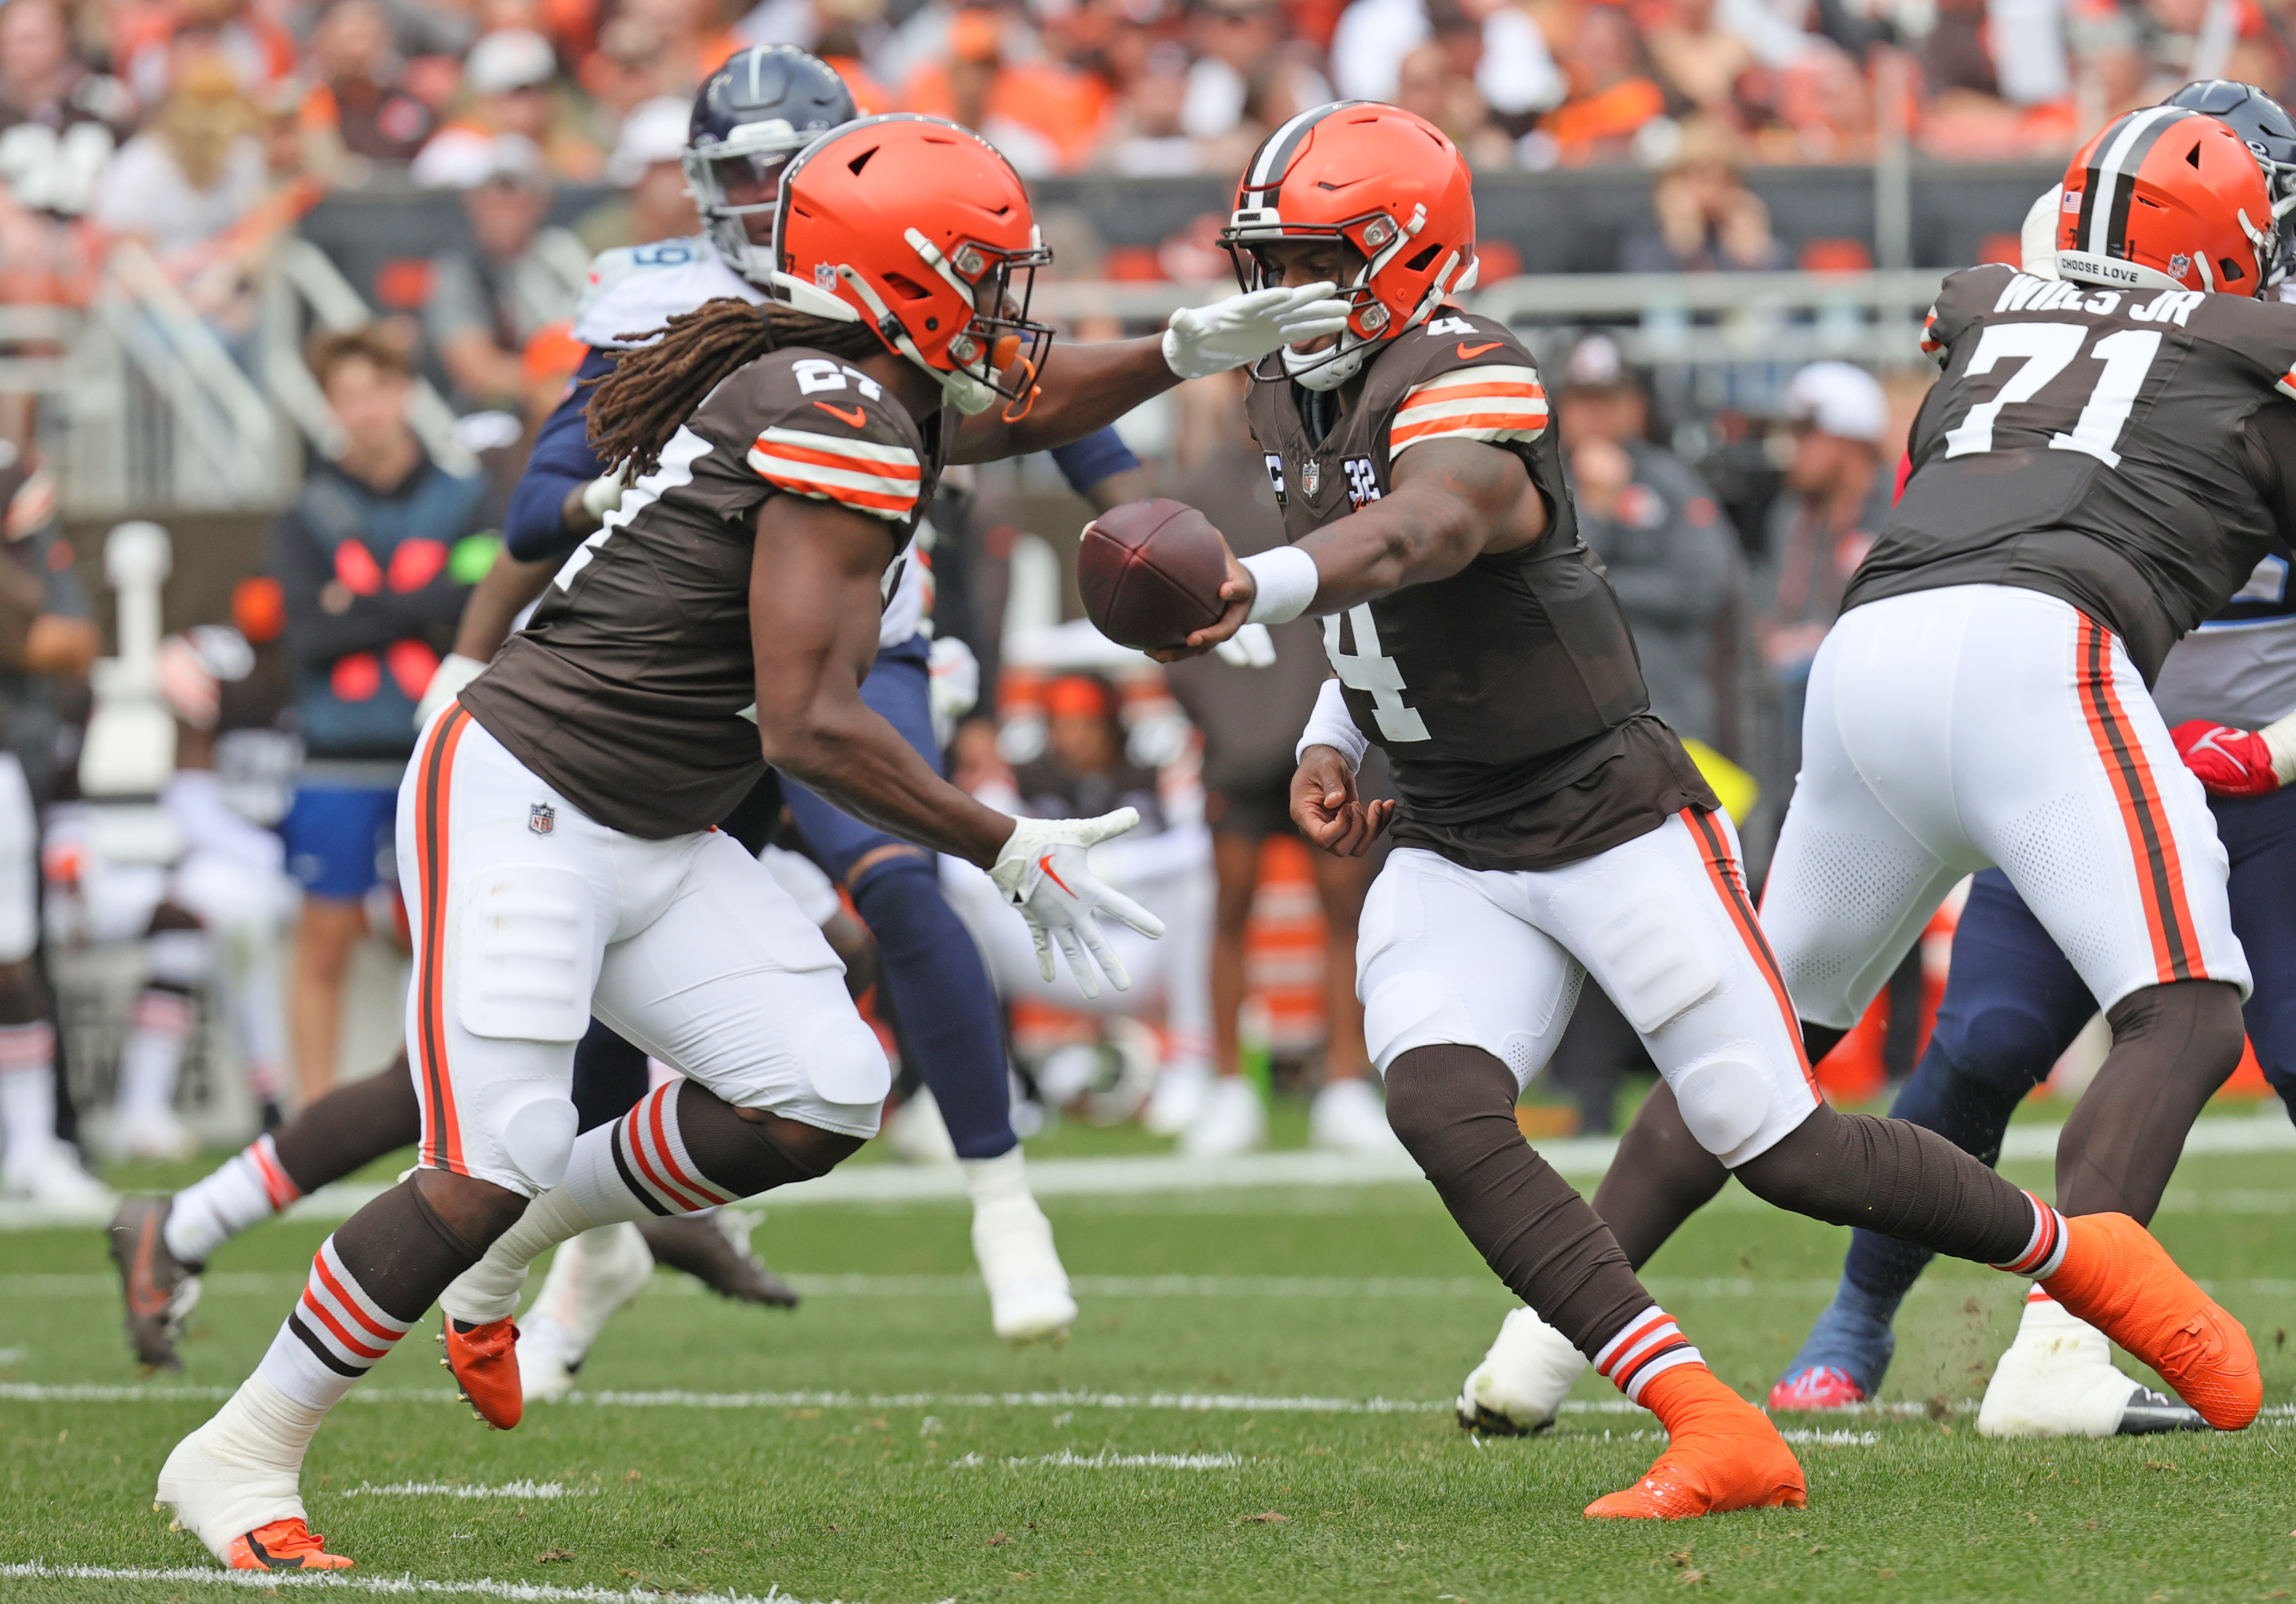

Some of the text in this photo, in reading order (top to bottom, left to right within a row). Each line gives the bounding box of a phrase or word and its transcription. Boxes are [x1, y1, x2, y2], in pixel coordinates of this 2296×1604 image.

[2062, 258, 2139, 283] CHOOSE LOVE
[1427, 316, 1480, 335] 4
[2129, 290, 2206, 327] JR
[1945, 323, 2162, 469] 71
[1265, 455, 1284, 492] C
[1344, 458, 1380, 502] 32
[1323, 601, 1432, 742] 4
